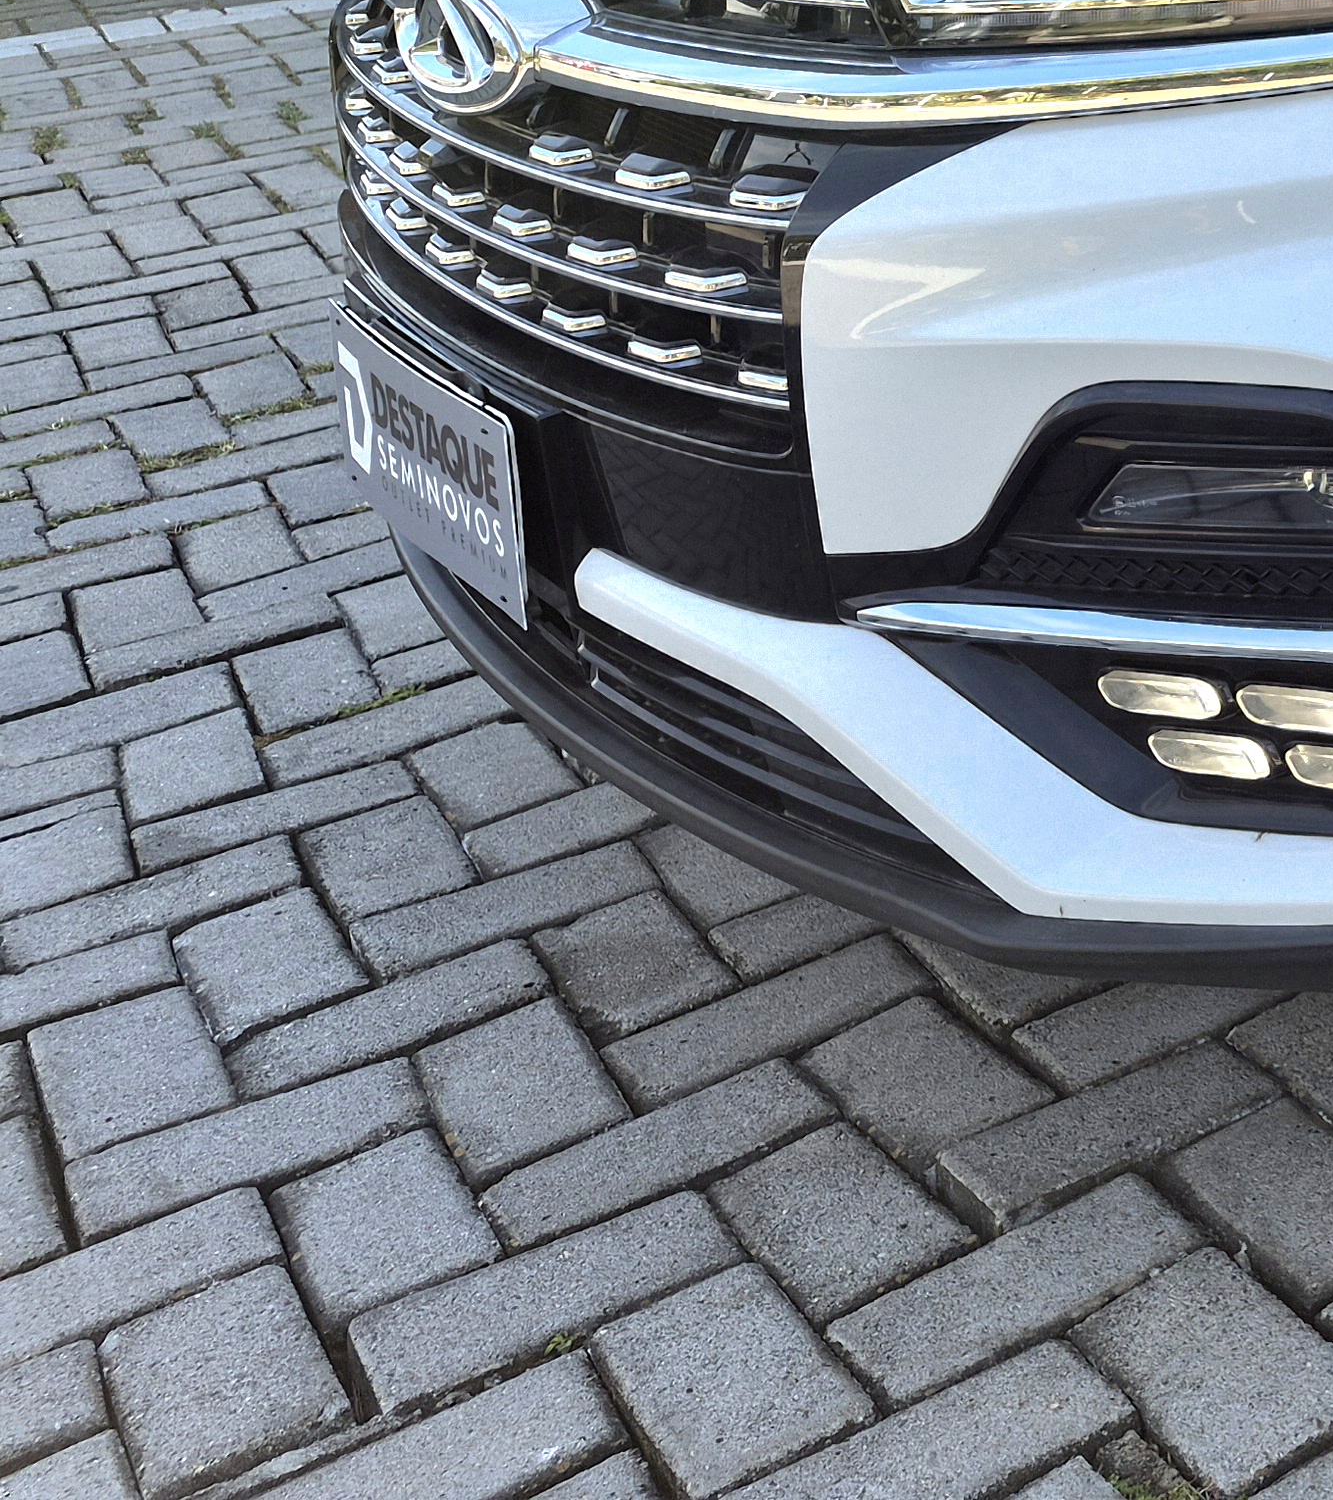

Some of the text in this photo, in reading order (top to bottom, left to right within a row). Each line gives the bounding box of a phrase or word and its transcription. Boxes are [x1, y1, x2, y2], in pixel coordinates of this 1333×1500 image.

[370, 371, 499, 512] DESTAQUE
[377, 434, 505, 557] SEMINOVOS
[381, 475, 509, 582] OUTLET PREMIUM
